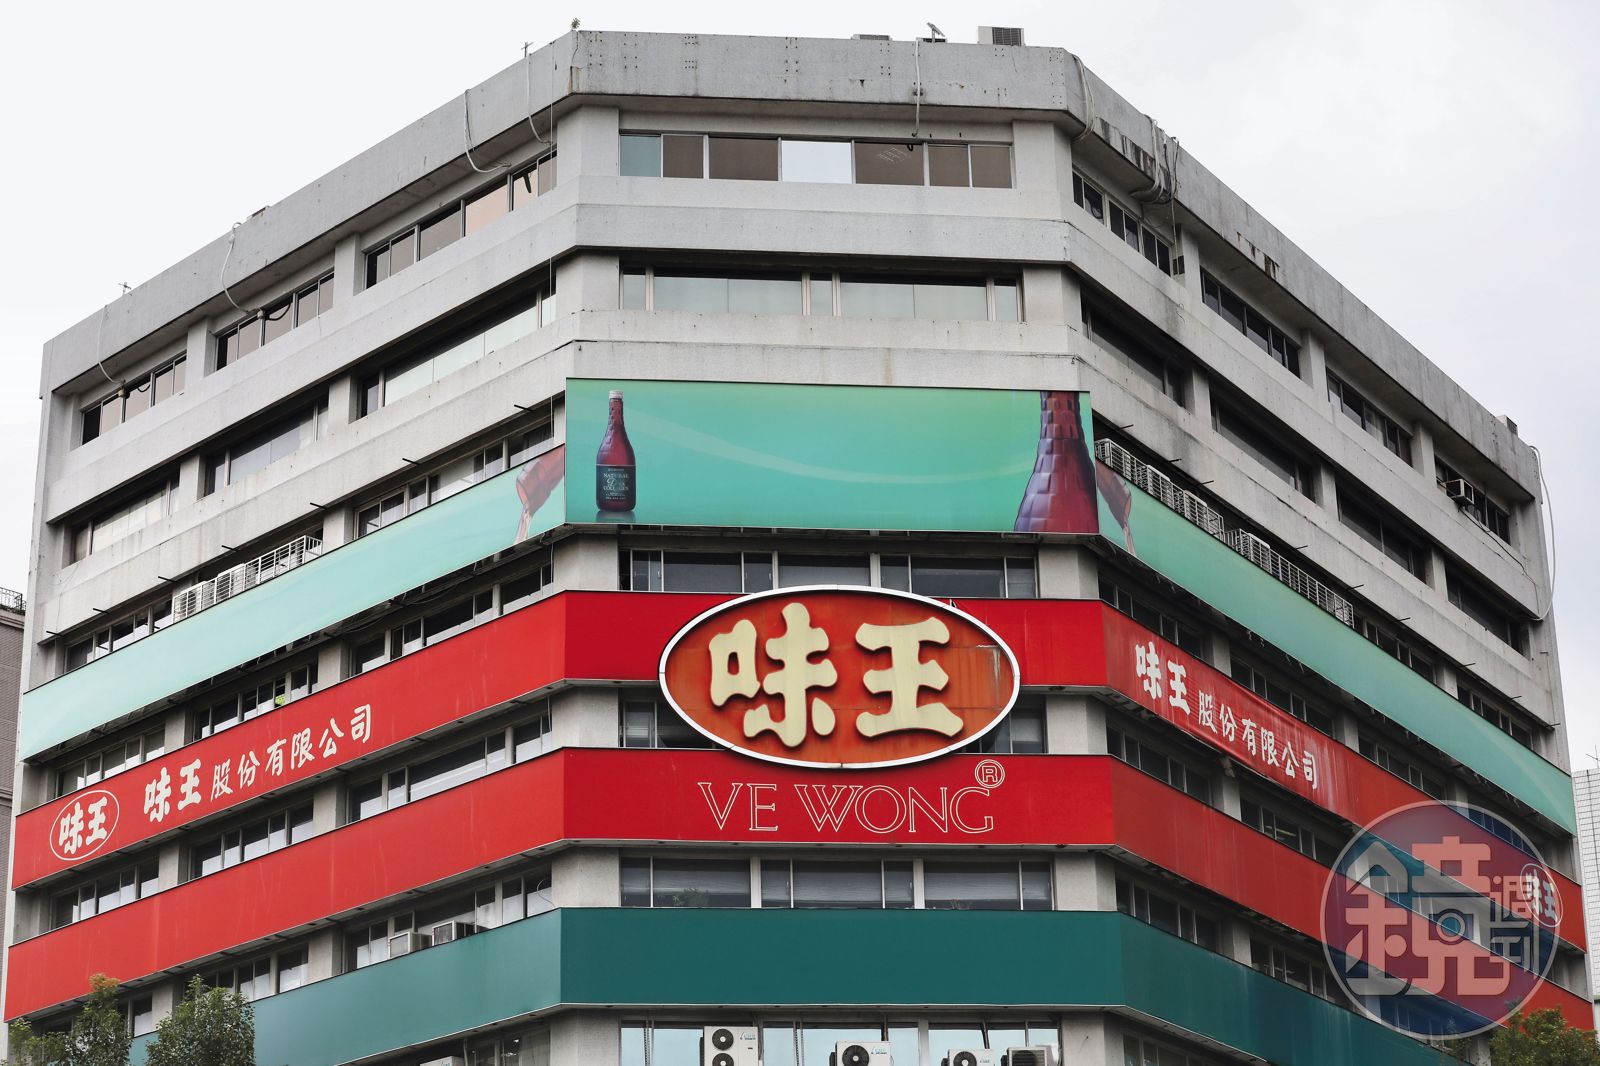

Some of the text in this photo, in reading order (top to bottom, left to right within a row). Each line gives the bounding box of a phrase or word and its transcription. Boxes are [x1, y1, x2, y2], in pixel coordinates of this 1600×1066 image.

[708, 602, 964, 747] 味王
[58, 795, 109, 856] 味王
[697, 782, 994, 834] VE WONG
